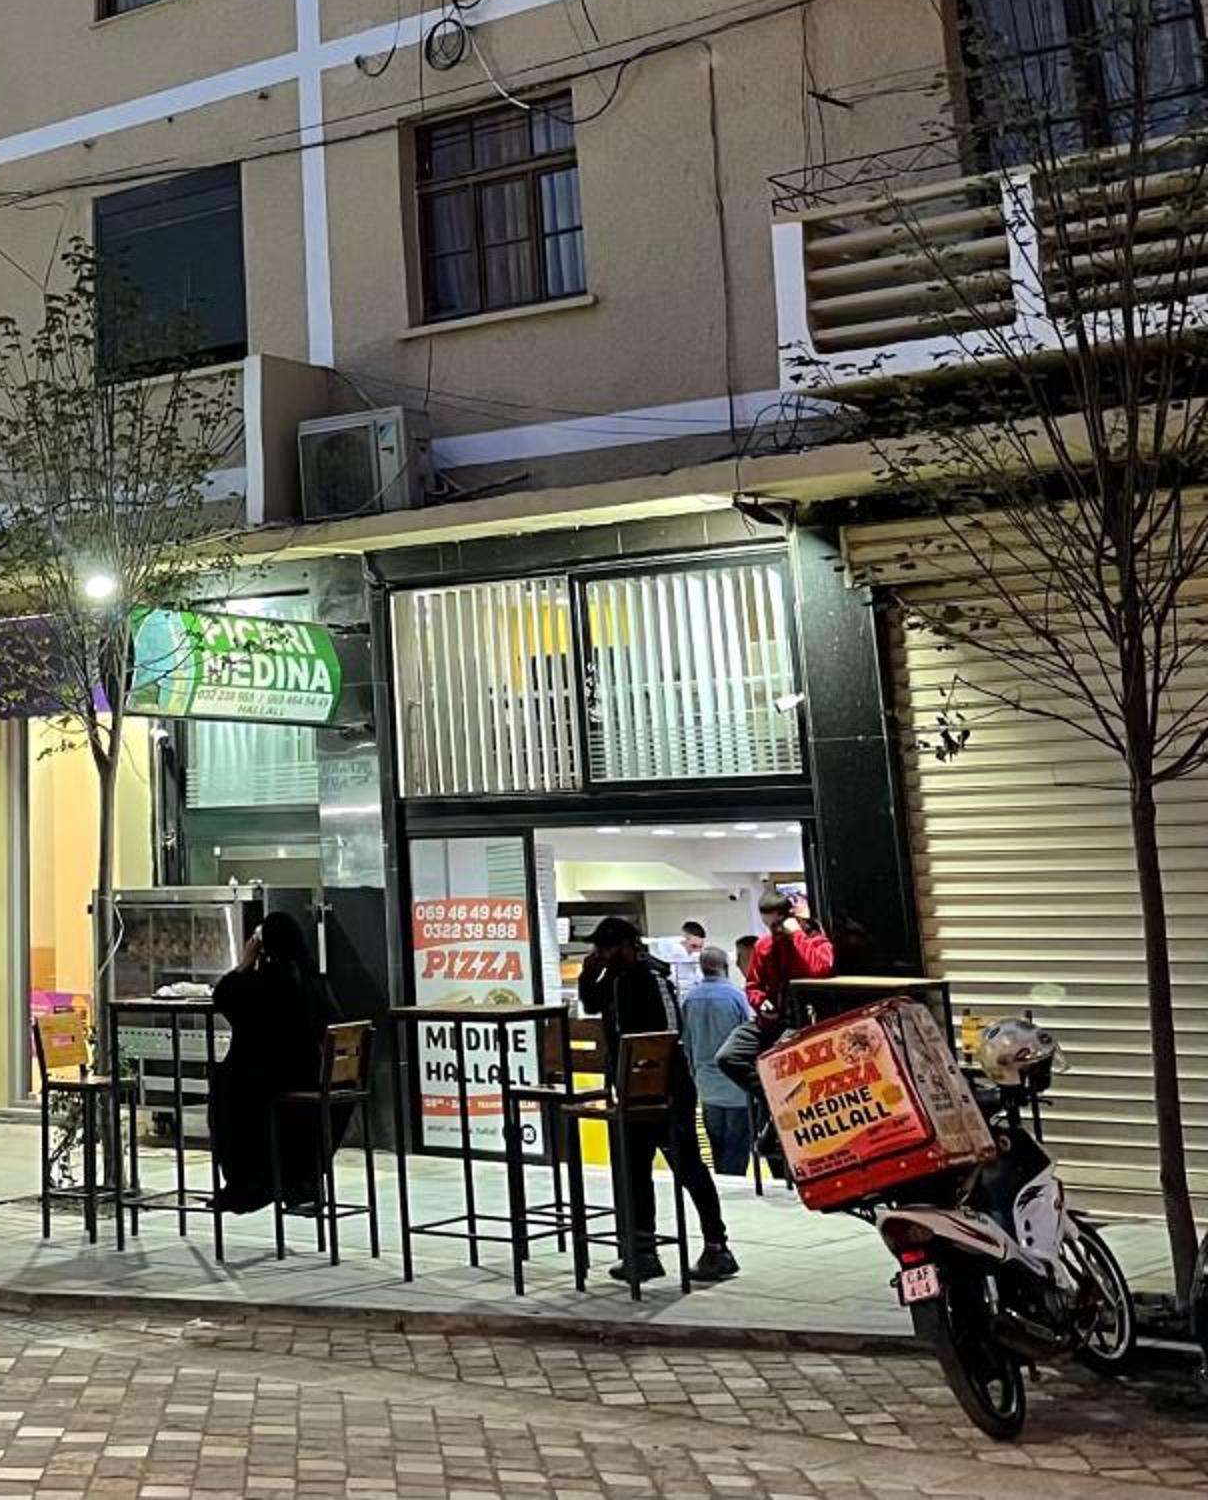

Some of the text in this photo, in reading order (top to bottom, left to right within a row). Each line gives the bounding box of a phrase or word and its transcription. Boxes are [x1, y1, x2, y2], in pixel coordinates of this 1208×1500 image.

[202, 649, 333, 694] MEDINA
[415, 905, 523, 920] 069 46 49 449
[422, 950, 524, 980] PIZZA
[769, 1038, 837, 1081] TAXI
[808, 1059, 882, 1103] PIZZA
[793, 1101, 892, 1146] HALLALL
[797, 1086, 873, 1124] MEDINE
